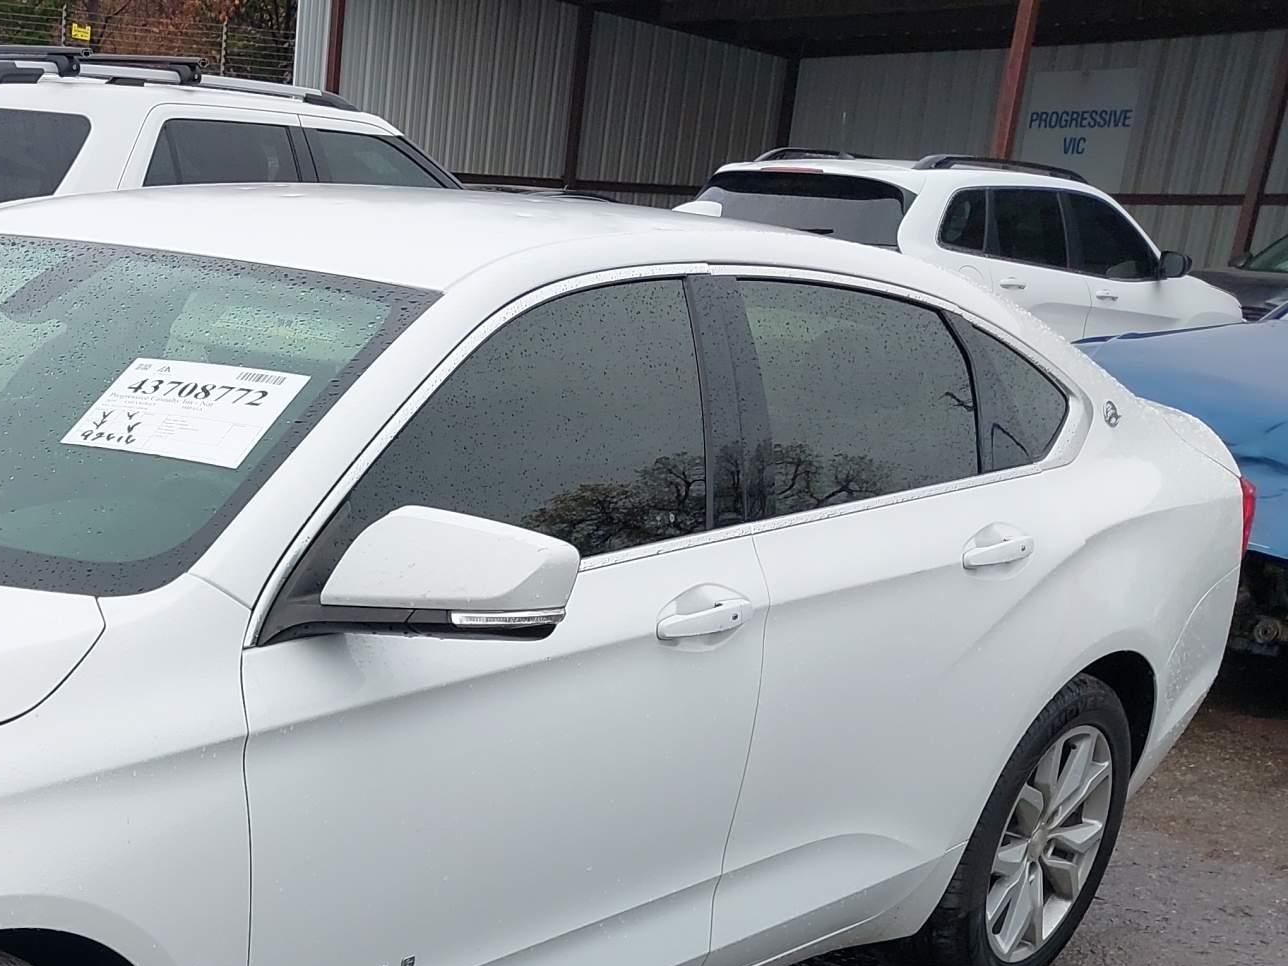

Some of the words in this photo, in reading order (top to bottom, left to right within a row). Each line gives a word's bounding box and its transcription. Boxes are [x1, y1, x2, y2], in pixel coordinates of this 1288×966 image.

[1029, 109, 1133, 129] PROGRESSIVE
[1062, 137, 1087, 155] VIC
[128, 378, 268, 406] 43708772
